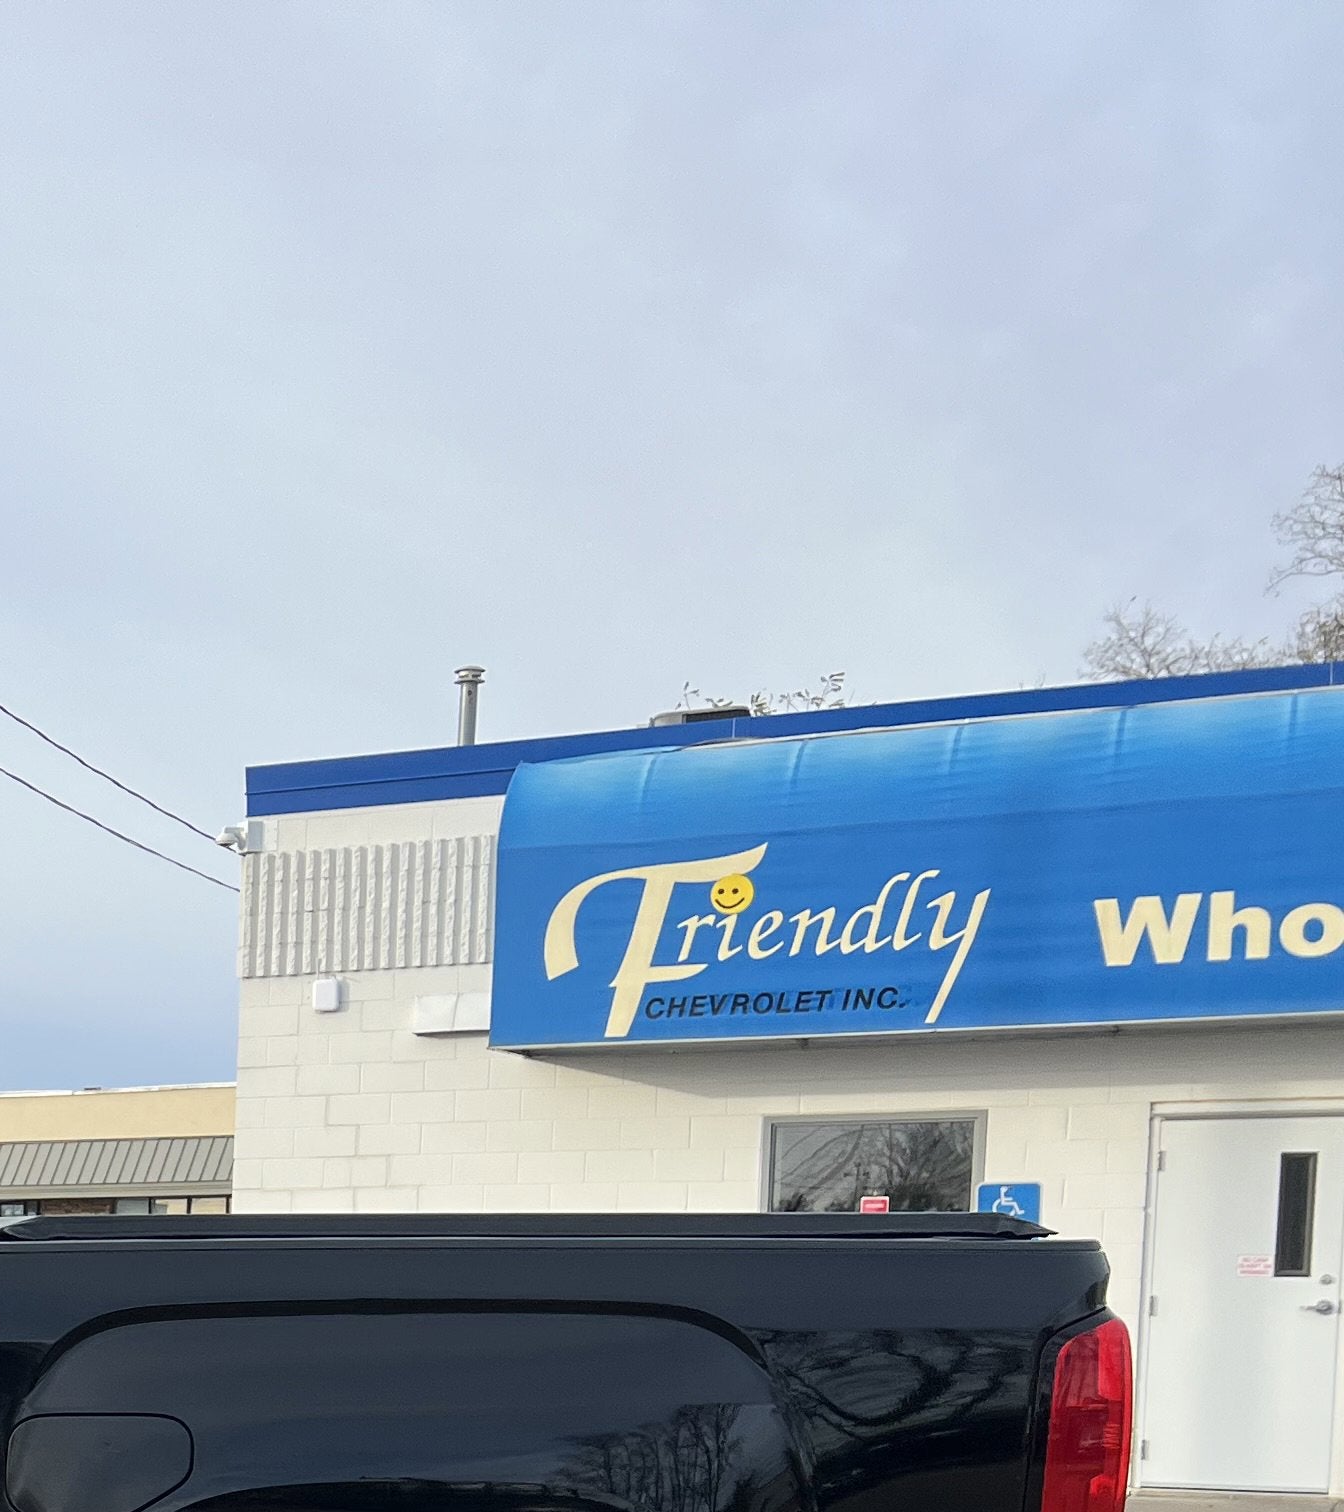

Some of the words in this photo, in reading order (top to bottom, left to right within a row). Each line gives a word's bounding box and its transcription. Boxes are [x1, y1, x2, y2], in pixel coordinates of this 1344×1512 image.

[544, 842, 991, 1037] Friendly
[1094, 890, 1344, 967] Who
[644, 989, 829, 1020] CHEVROLET
[841, 985, 909, 1013] INC.
